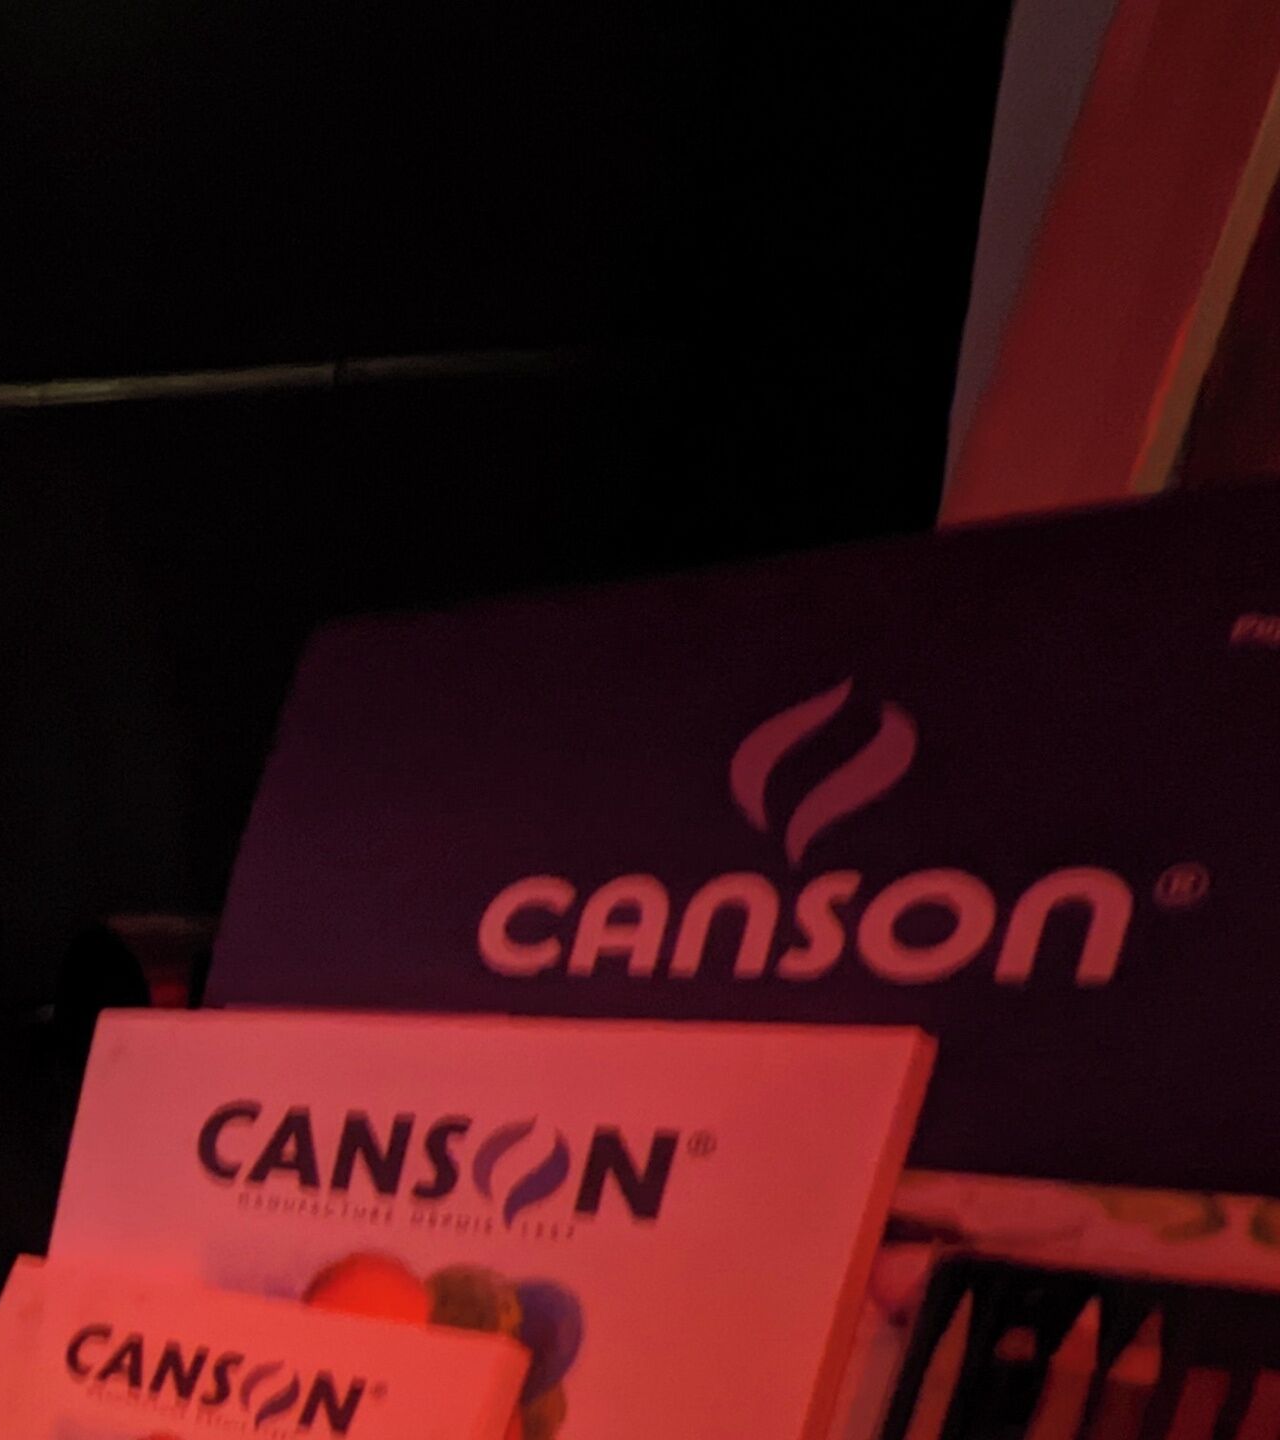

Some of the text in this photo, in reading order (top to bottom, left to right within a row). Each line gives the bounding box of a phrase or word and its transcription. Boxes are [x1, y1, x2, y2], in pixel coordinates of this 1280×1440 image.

[478, 867, 1134, 987] CANSON
[197, 1100, 680, 1223] CANSON
[66, 1323, 366, 1437] CANSON
